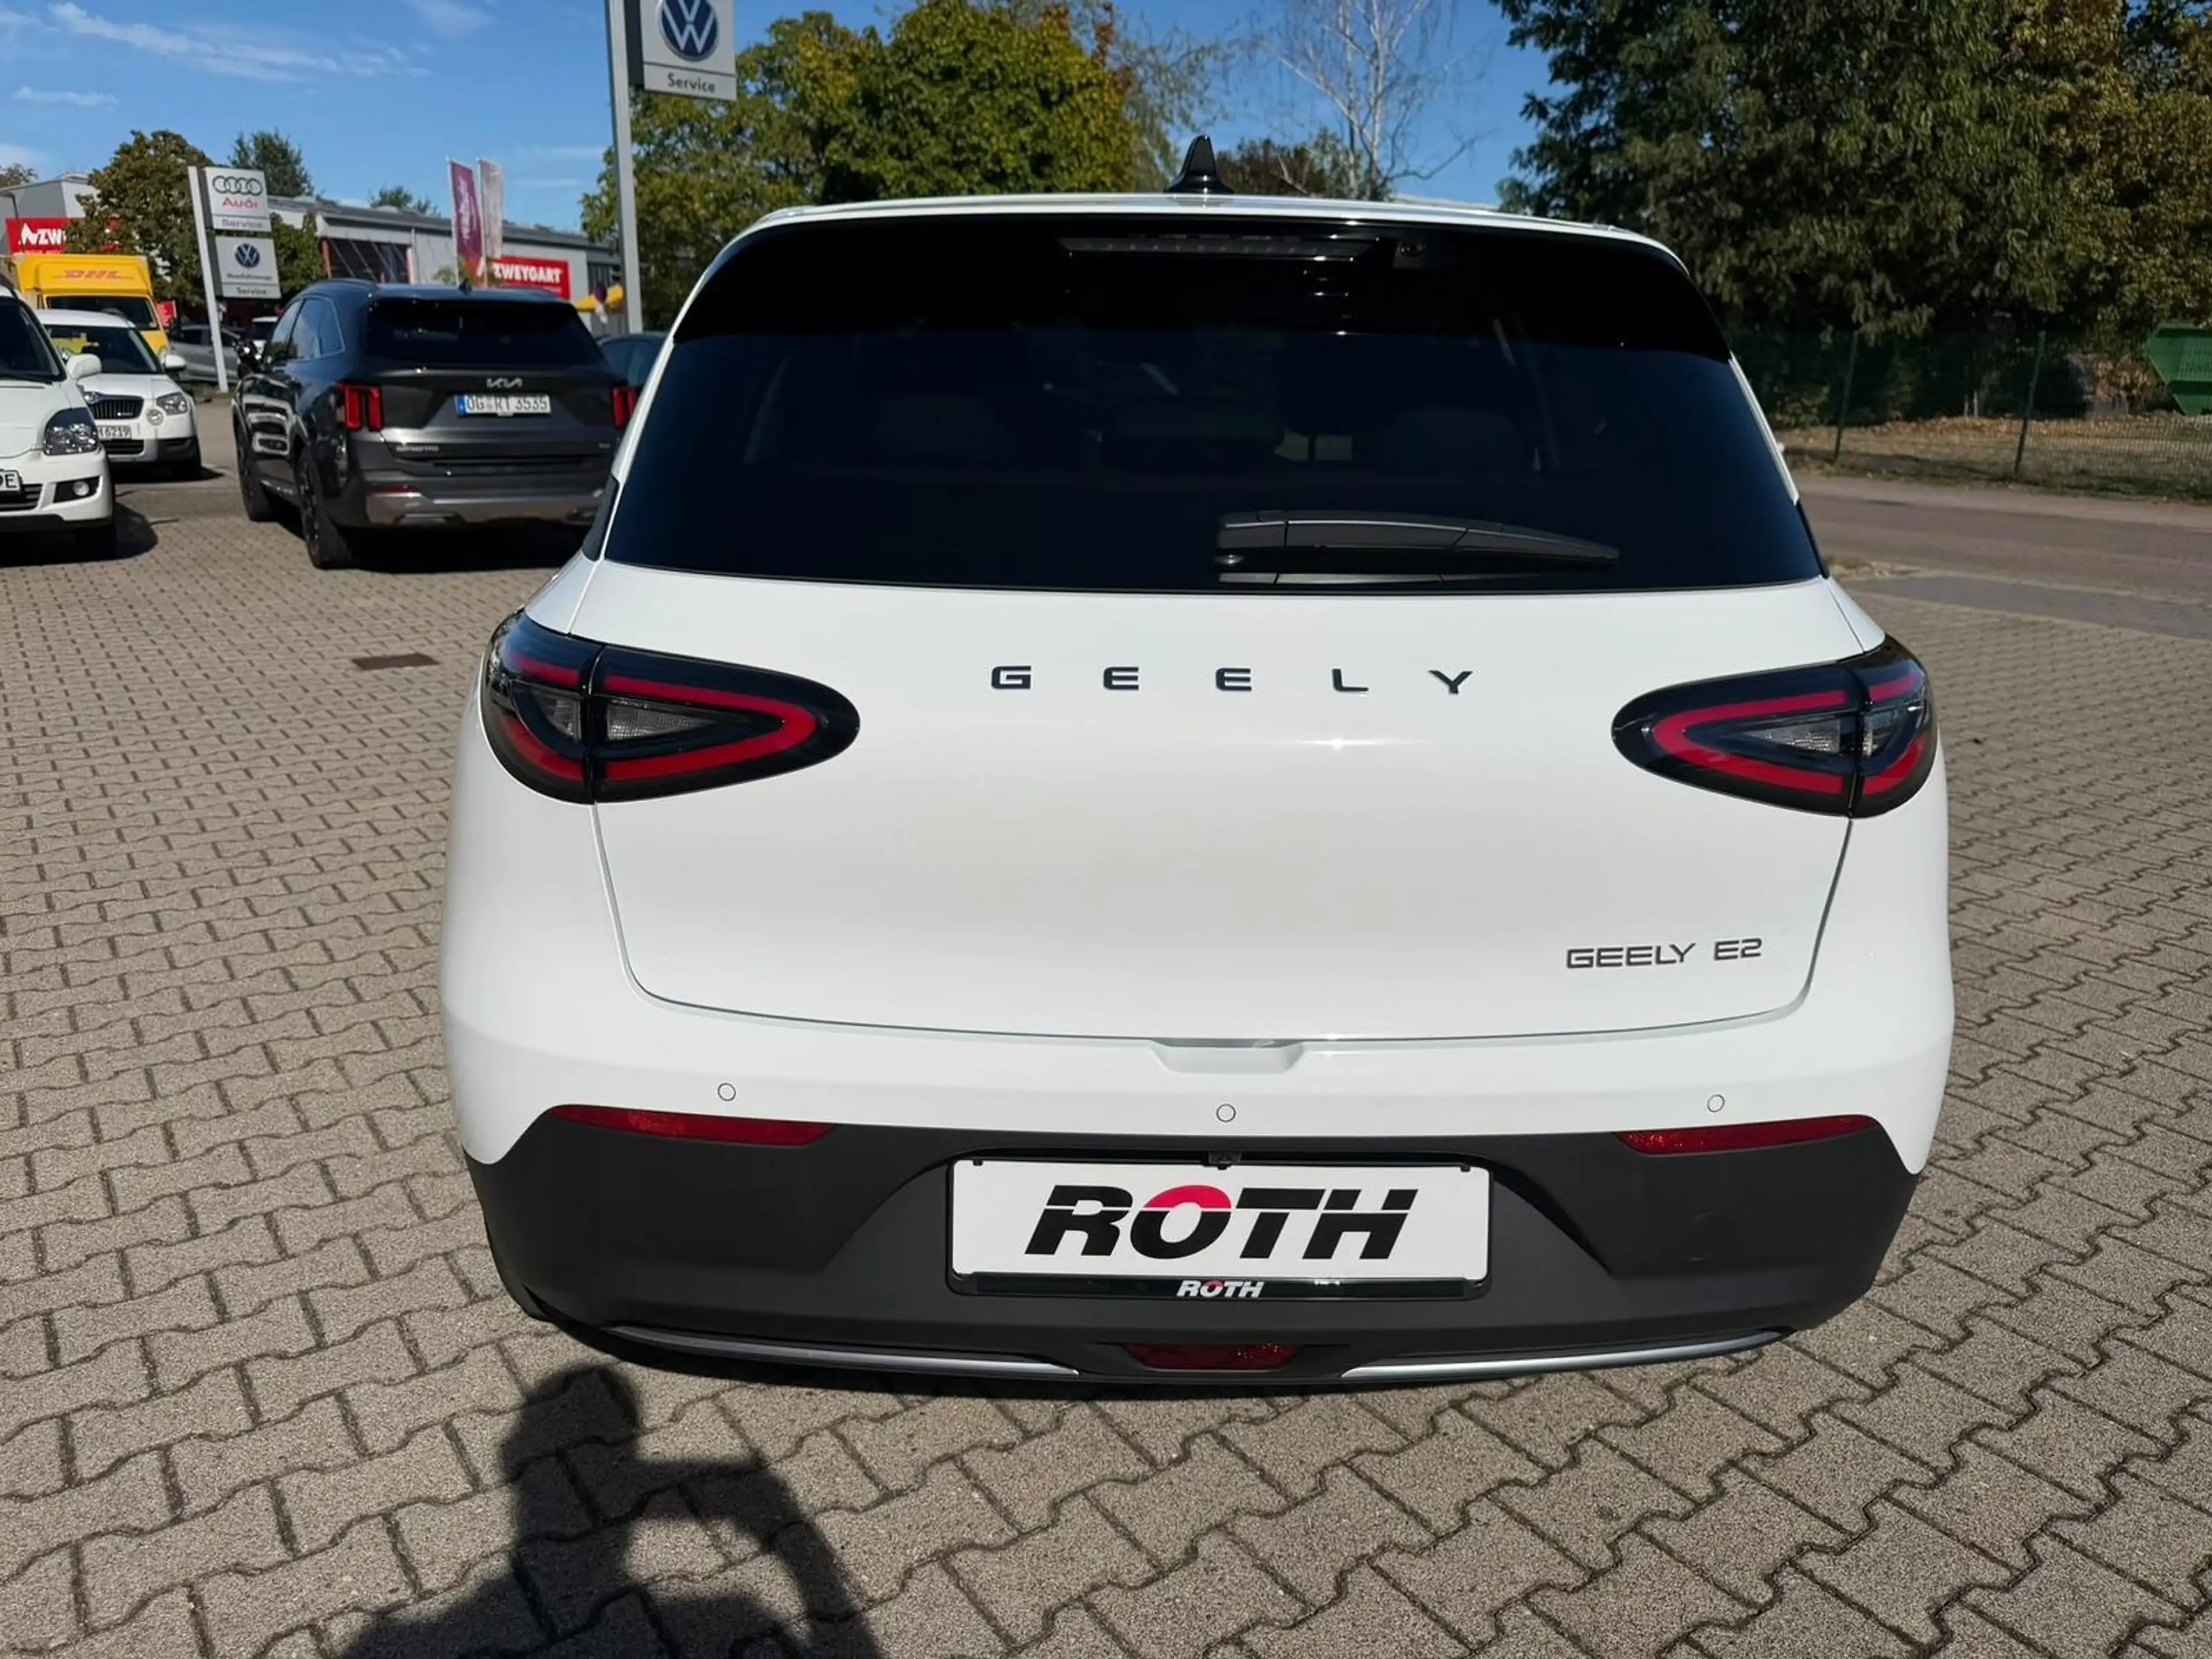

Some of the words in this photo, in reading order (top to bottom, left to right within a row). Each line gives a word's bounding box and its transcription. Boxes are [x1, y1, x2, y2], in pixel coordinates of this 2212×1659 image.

[667, 72, 716, 93] Service
[222, 198, 258, 209] Audi
[65, 270, 122, 279] DHL
[516, 396, 548, 411] 3535
[991, 665, 1473, 695] GEELY
[1566, 942, 1696, 969] GEELY
[1714, 938, 1762, 961] E2
[1024, 1184, 1419, 1260] ROTH
[1176, 1280, 1265, 1298] ROTH
